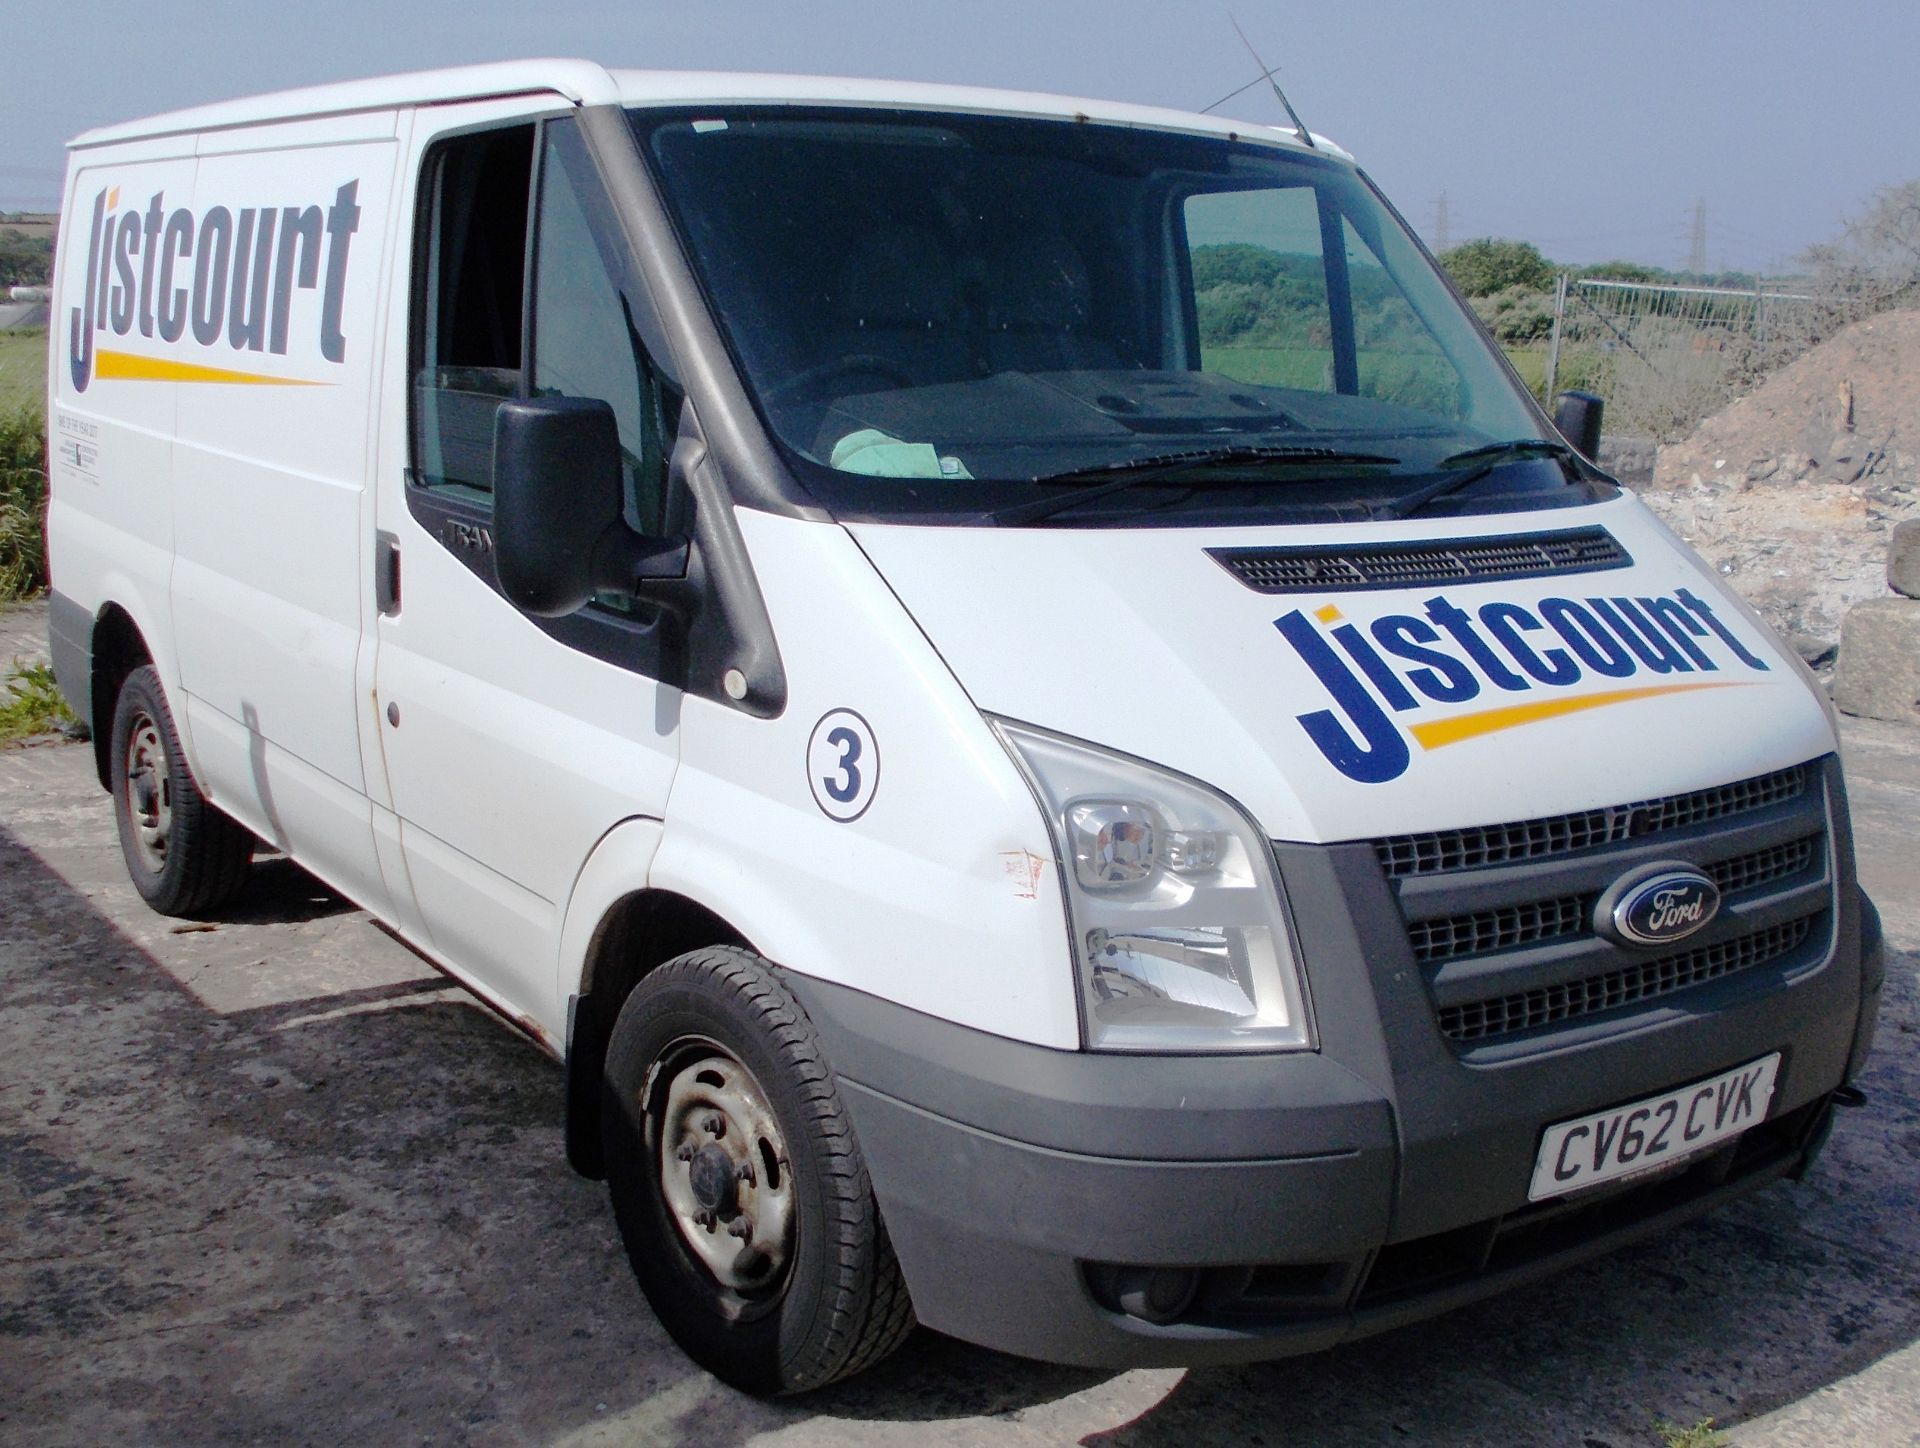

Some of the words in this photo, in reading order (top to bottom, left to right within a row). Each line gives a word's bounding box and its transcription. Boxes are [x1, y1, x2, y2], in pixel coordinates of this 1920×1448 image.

[71, 178, 361, 393] Jistcourt
[1272, 587, 1771, 783] Jistcourt
[823, 726, 862, 803] 3
[1649, 886, 1703, 931] Ford
[1554, 1100, 1679, 1181] CV62
[1683, 1066, 1763, 1141] CVK
